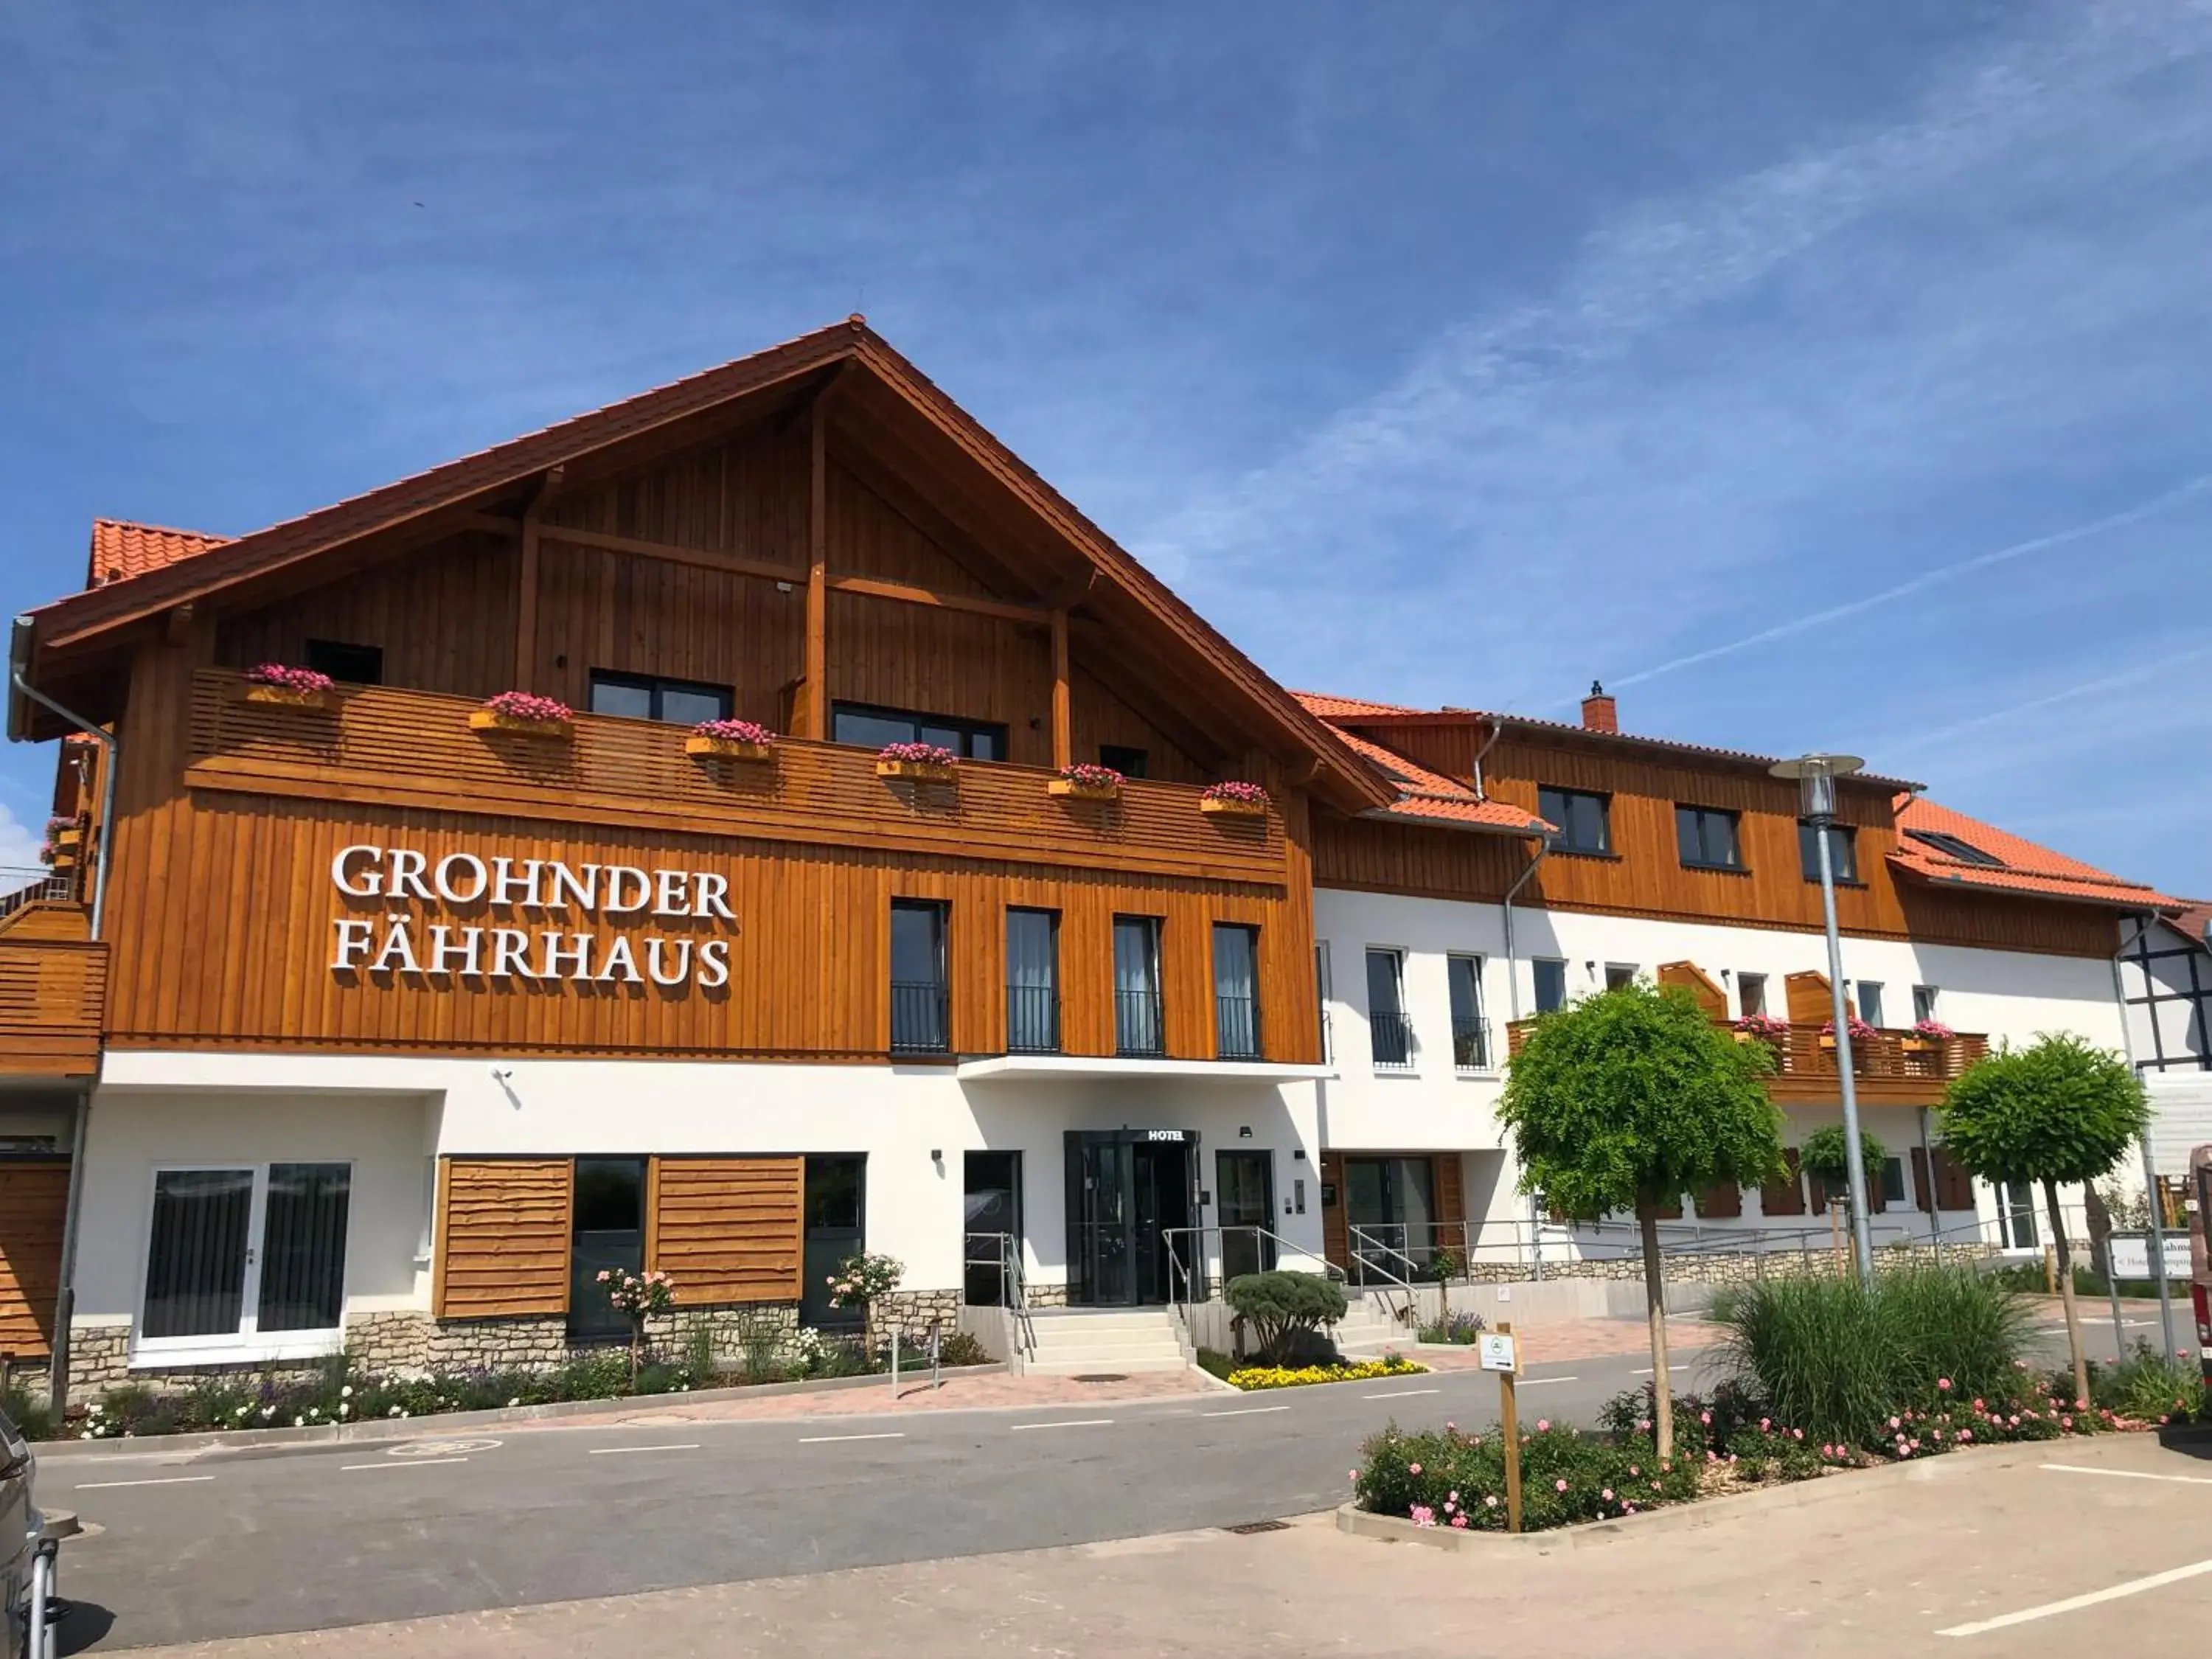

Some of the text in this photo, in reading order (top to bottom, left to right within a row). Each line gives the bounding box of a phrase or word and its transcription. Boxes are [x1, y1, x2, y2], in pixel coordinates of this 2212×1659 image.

[331, 845, 737, 919] GROHNDER
[330, 914, 729, 987] FÄHRHAUS
[1148, 1130, 1185, 1141] HOTEL
